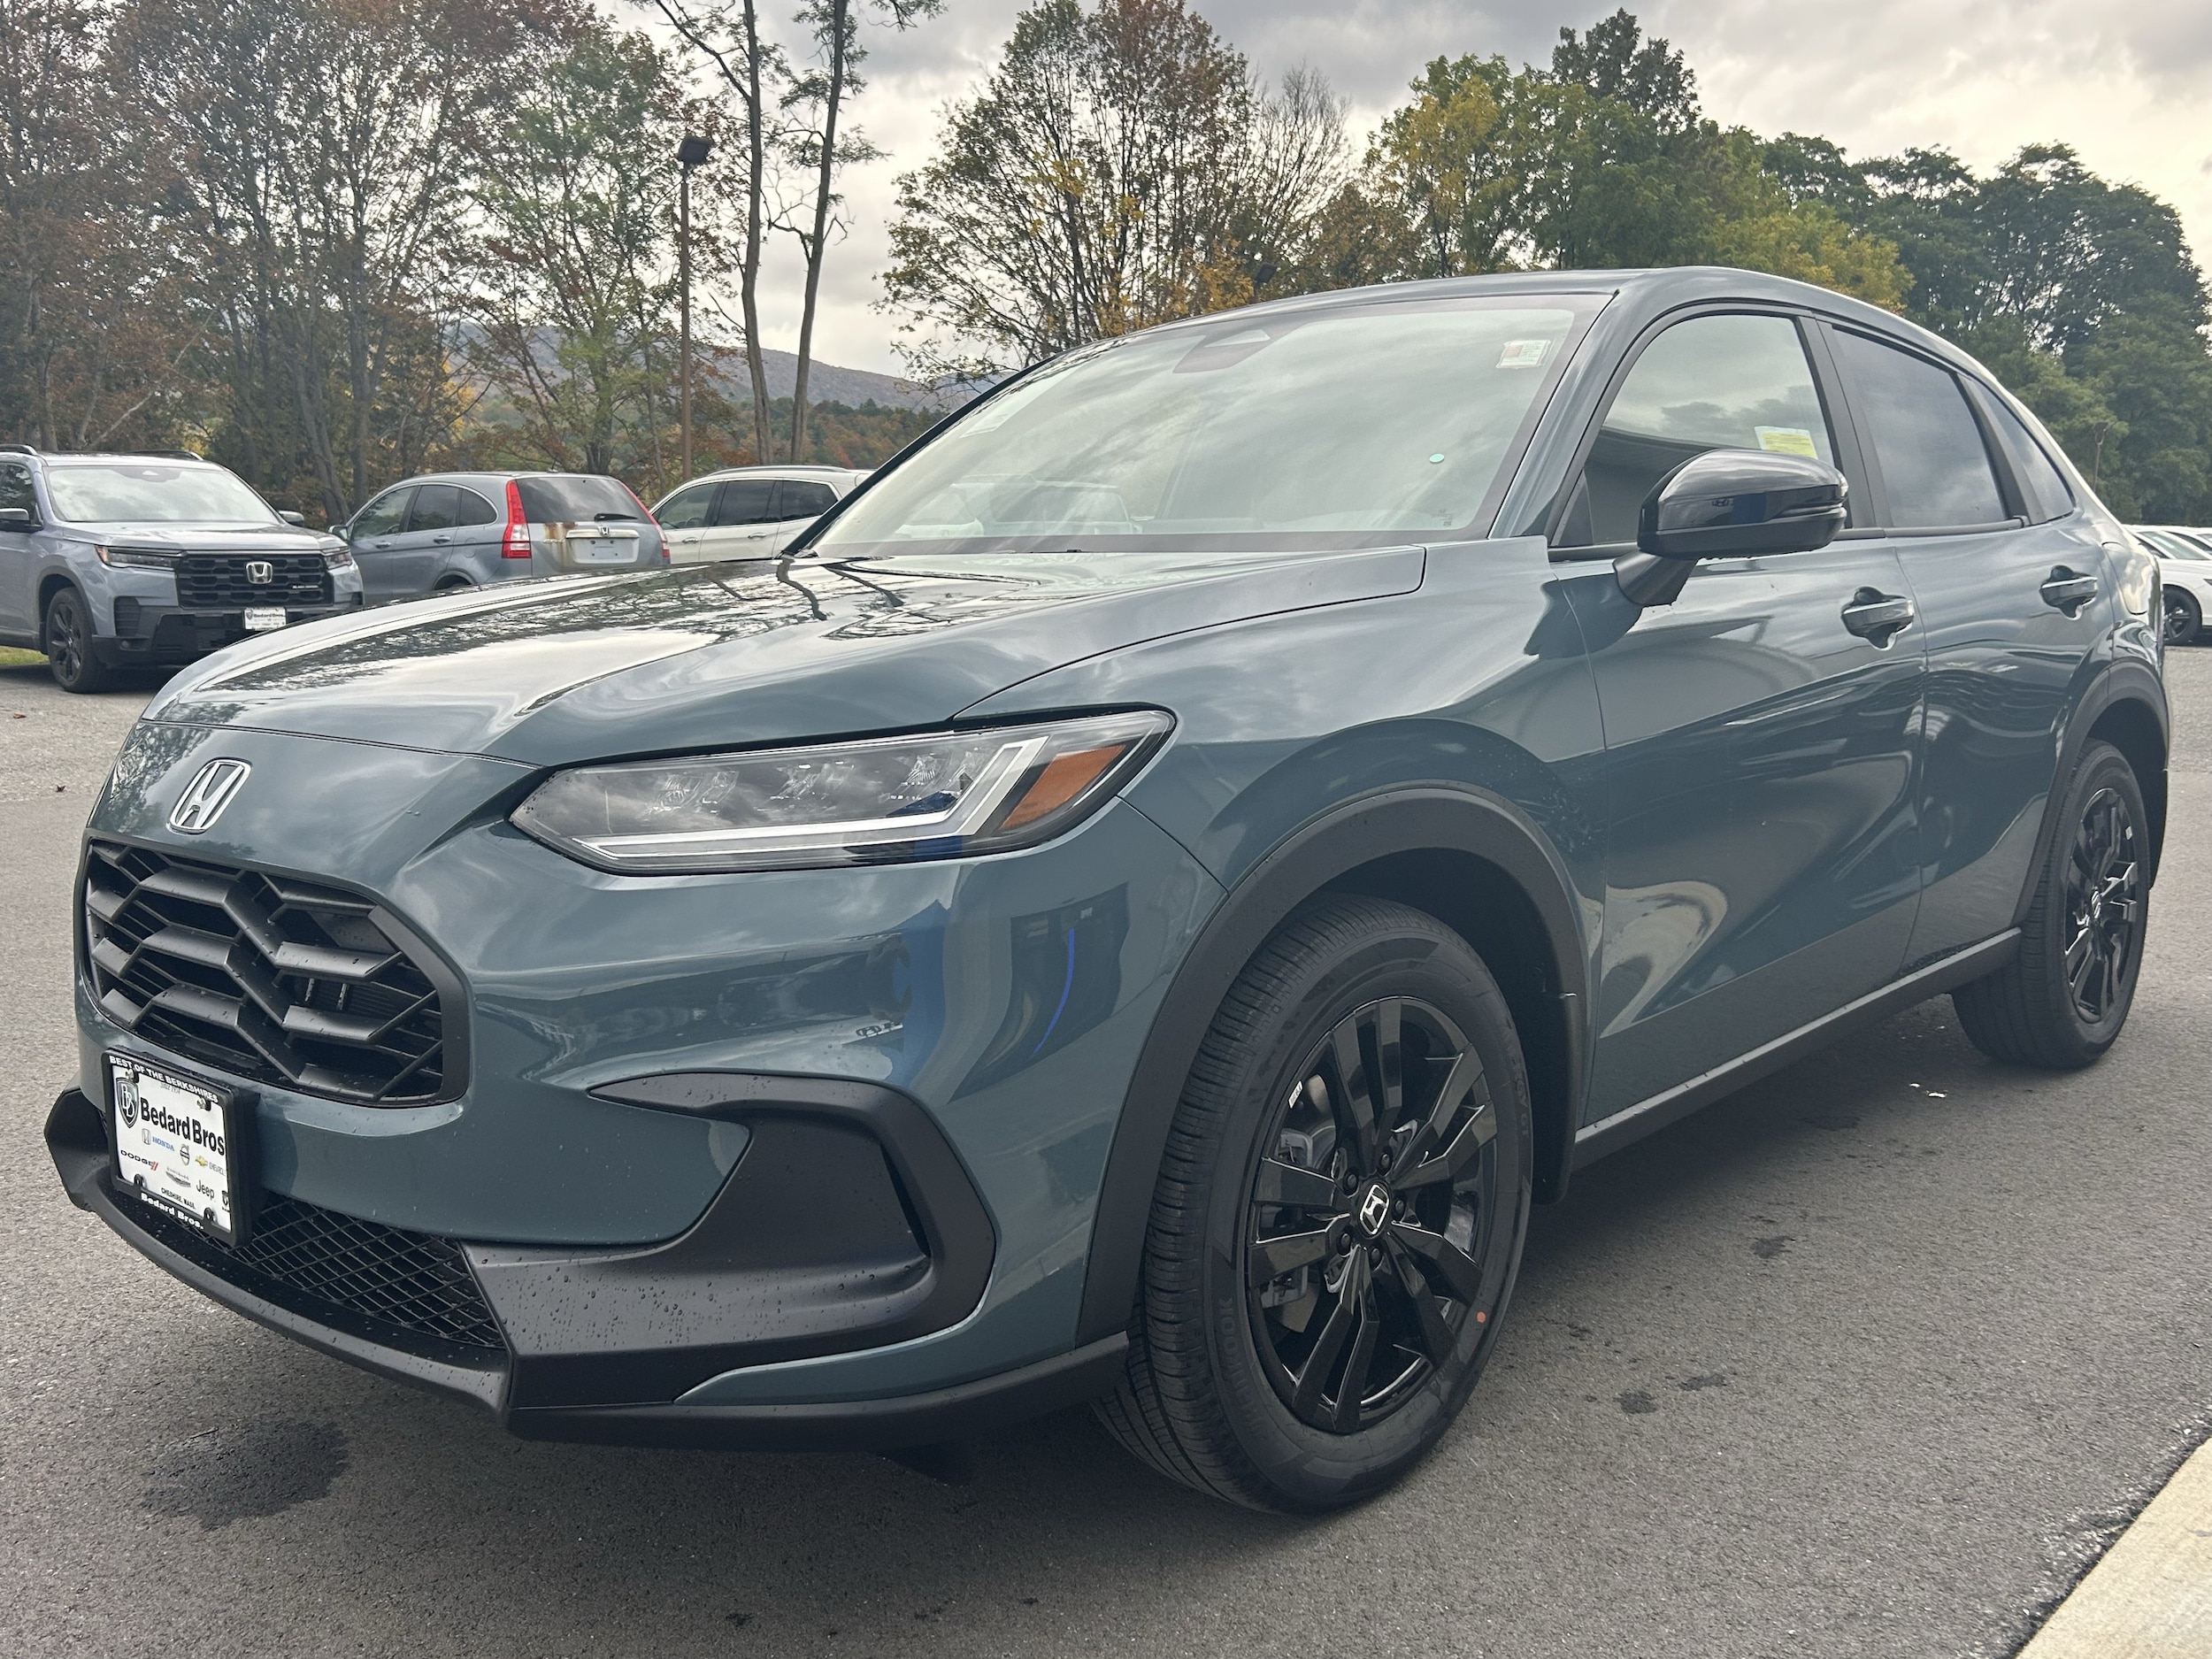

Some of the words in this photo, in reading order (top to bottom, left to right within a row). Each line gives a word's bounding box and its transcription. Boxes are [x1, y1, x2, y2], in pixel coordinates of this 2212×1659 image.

[109, 1055, 133, 1069] BEST
[134, 1064, 145, 1073] OF
[146, 1068, 165, 1081] THE
[165, 1075, 219, 1103] BERKSHIRES
[152, 1136, 175, 1152] HONDA
[196, 1179, 215, 1201] Jeep
[141, 1192, 175, 1216] Bedard
[177, 1210, 204, 1230] Bros.
